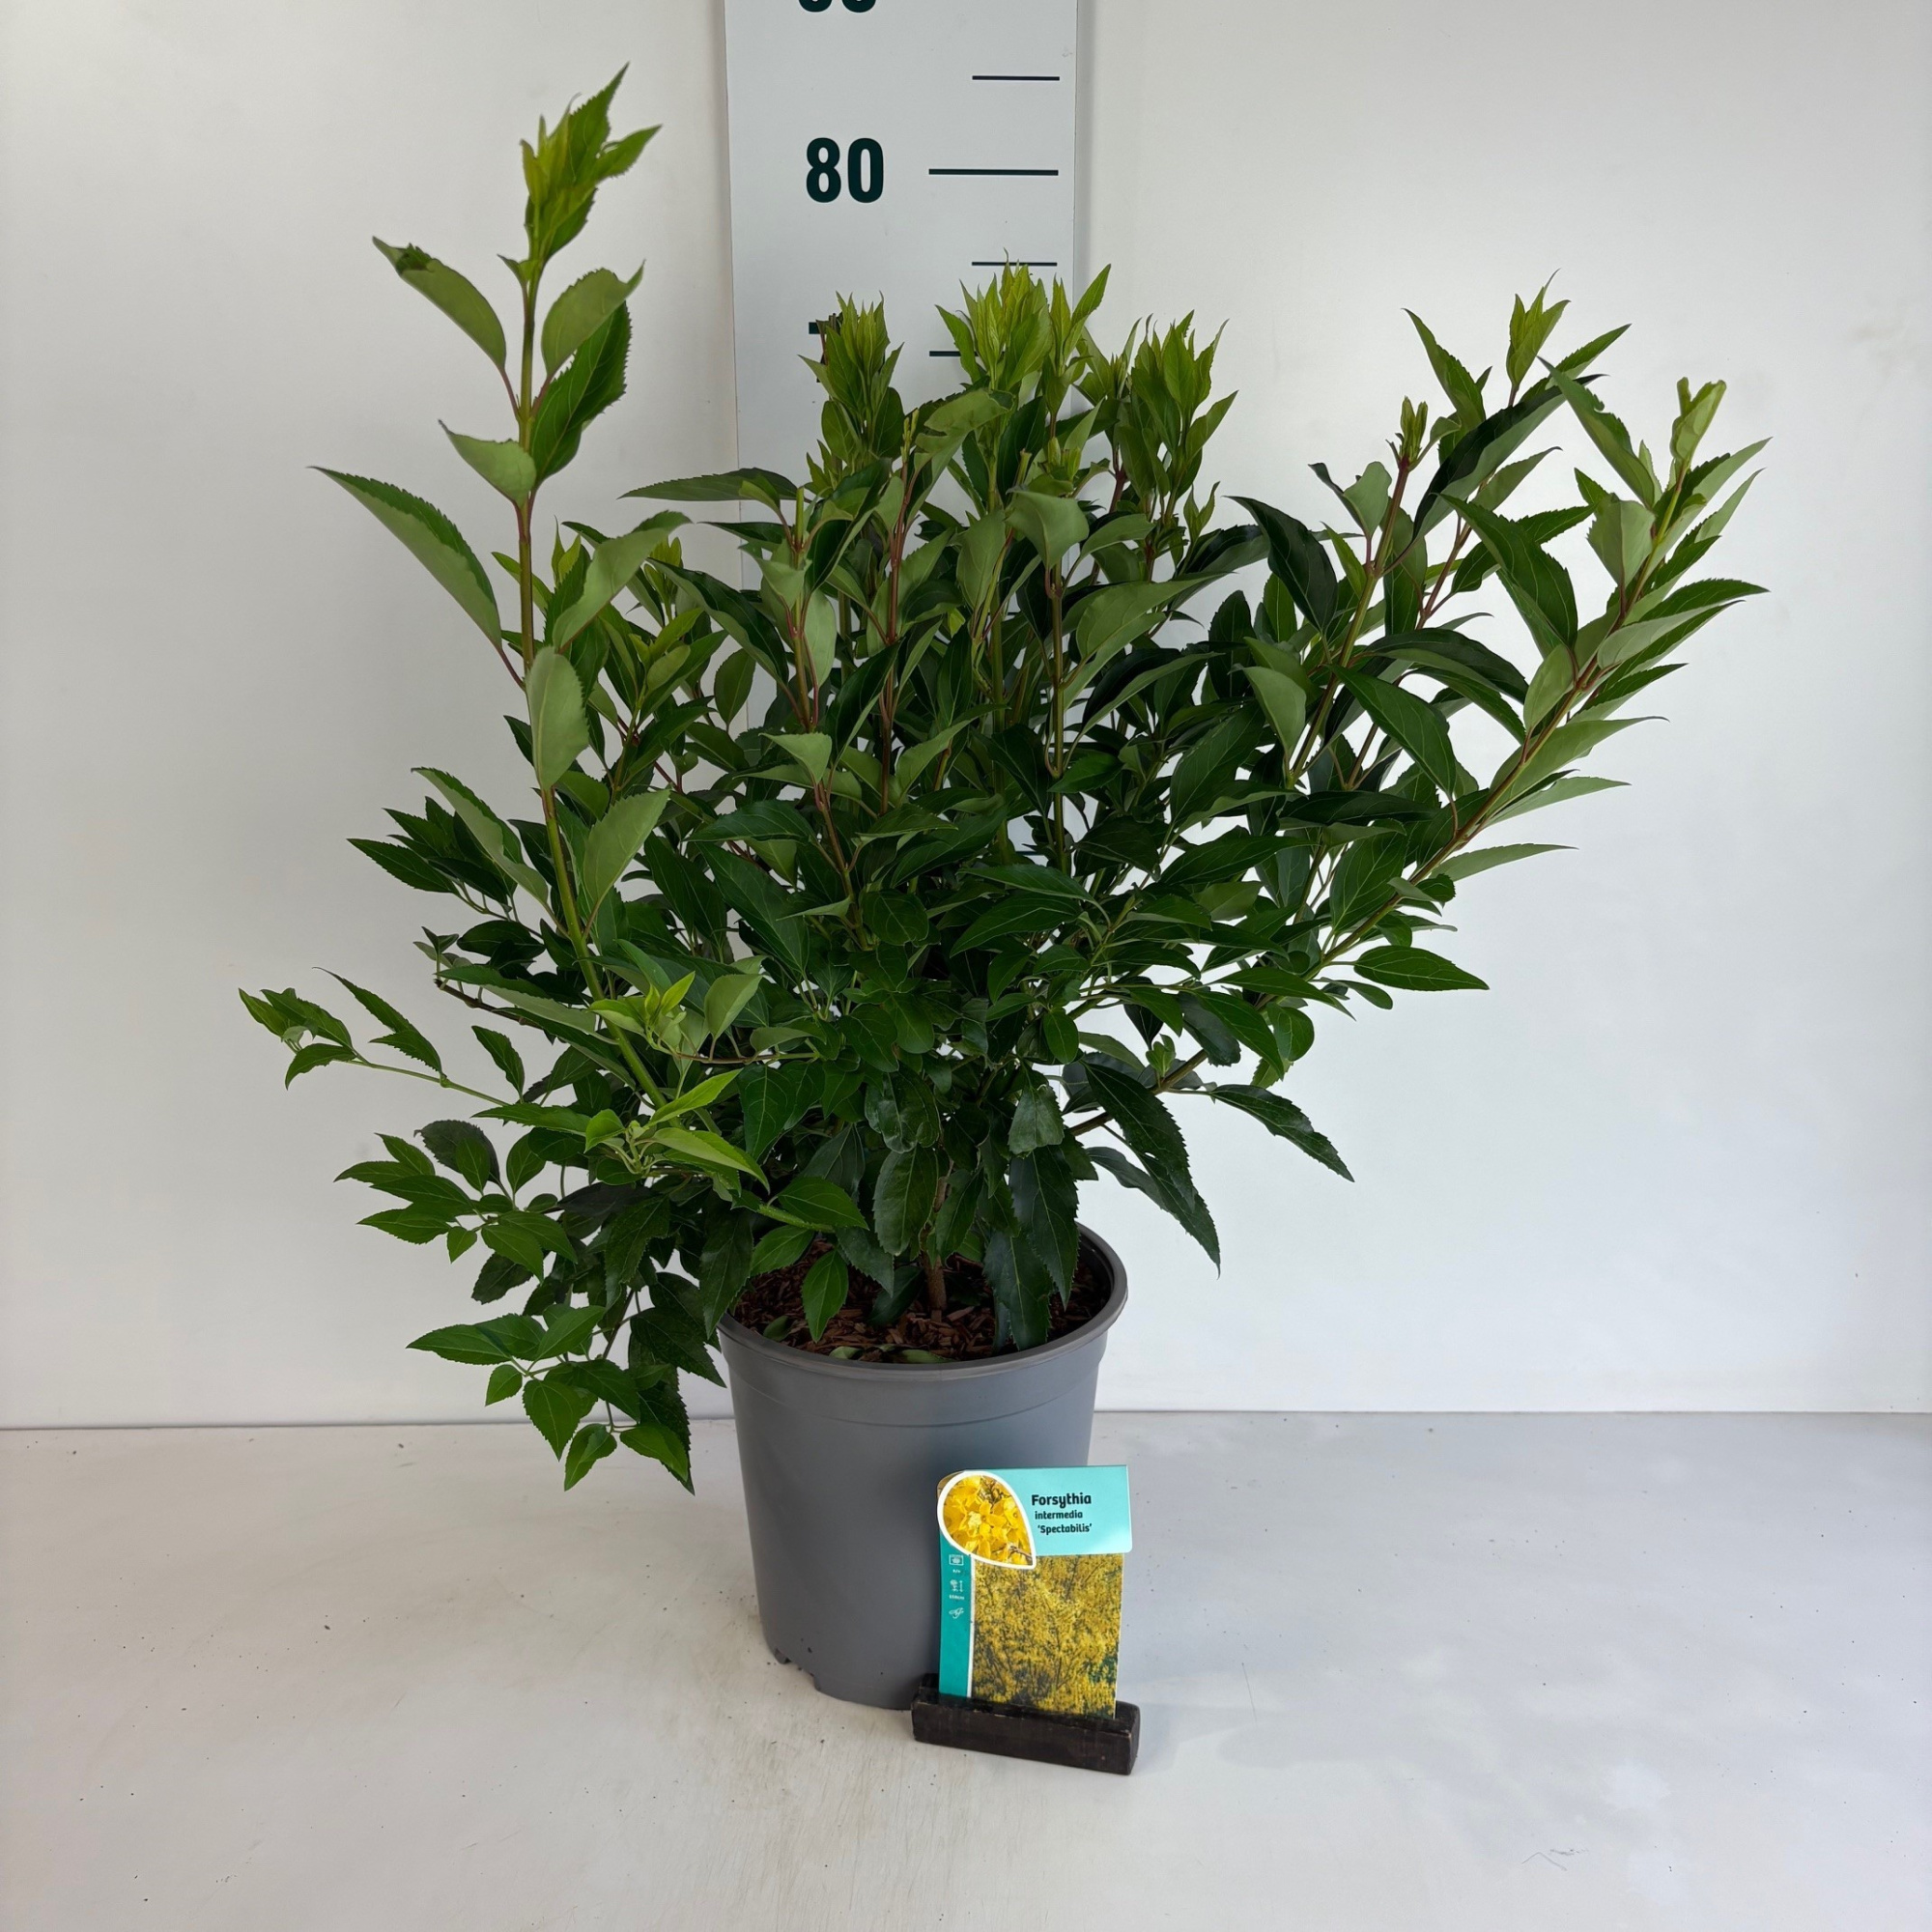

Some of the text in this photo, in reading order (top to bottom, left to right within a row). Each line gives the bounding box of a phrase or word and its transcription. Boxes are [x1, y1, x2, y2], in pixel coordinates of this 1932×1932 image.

[806, 137, 884, 204] 80
[1031, 1492, 1092, 1509] Forsythia
[1035, 1510, 1083, 1520] intermedia
